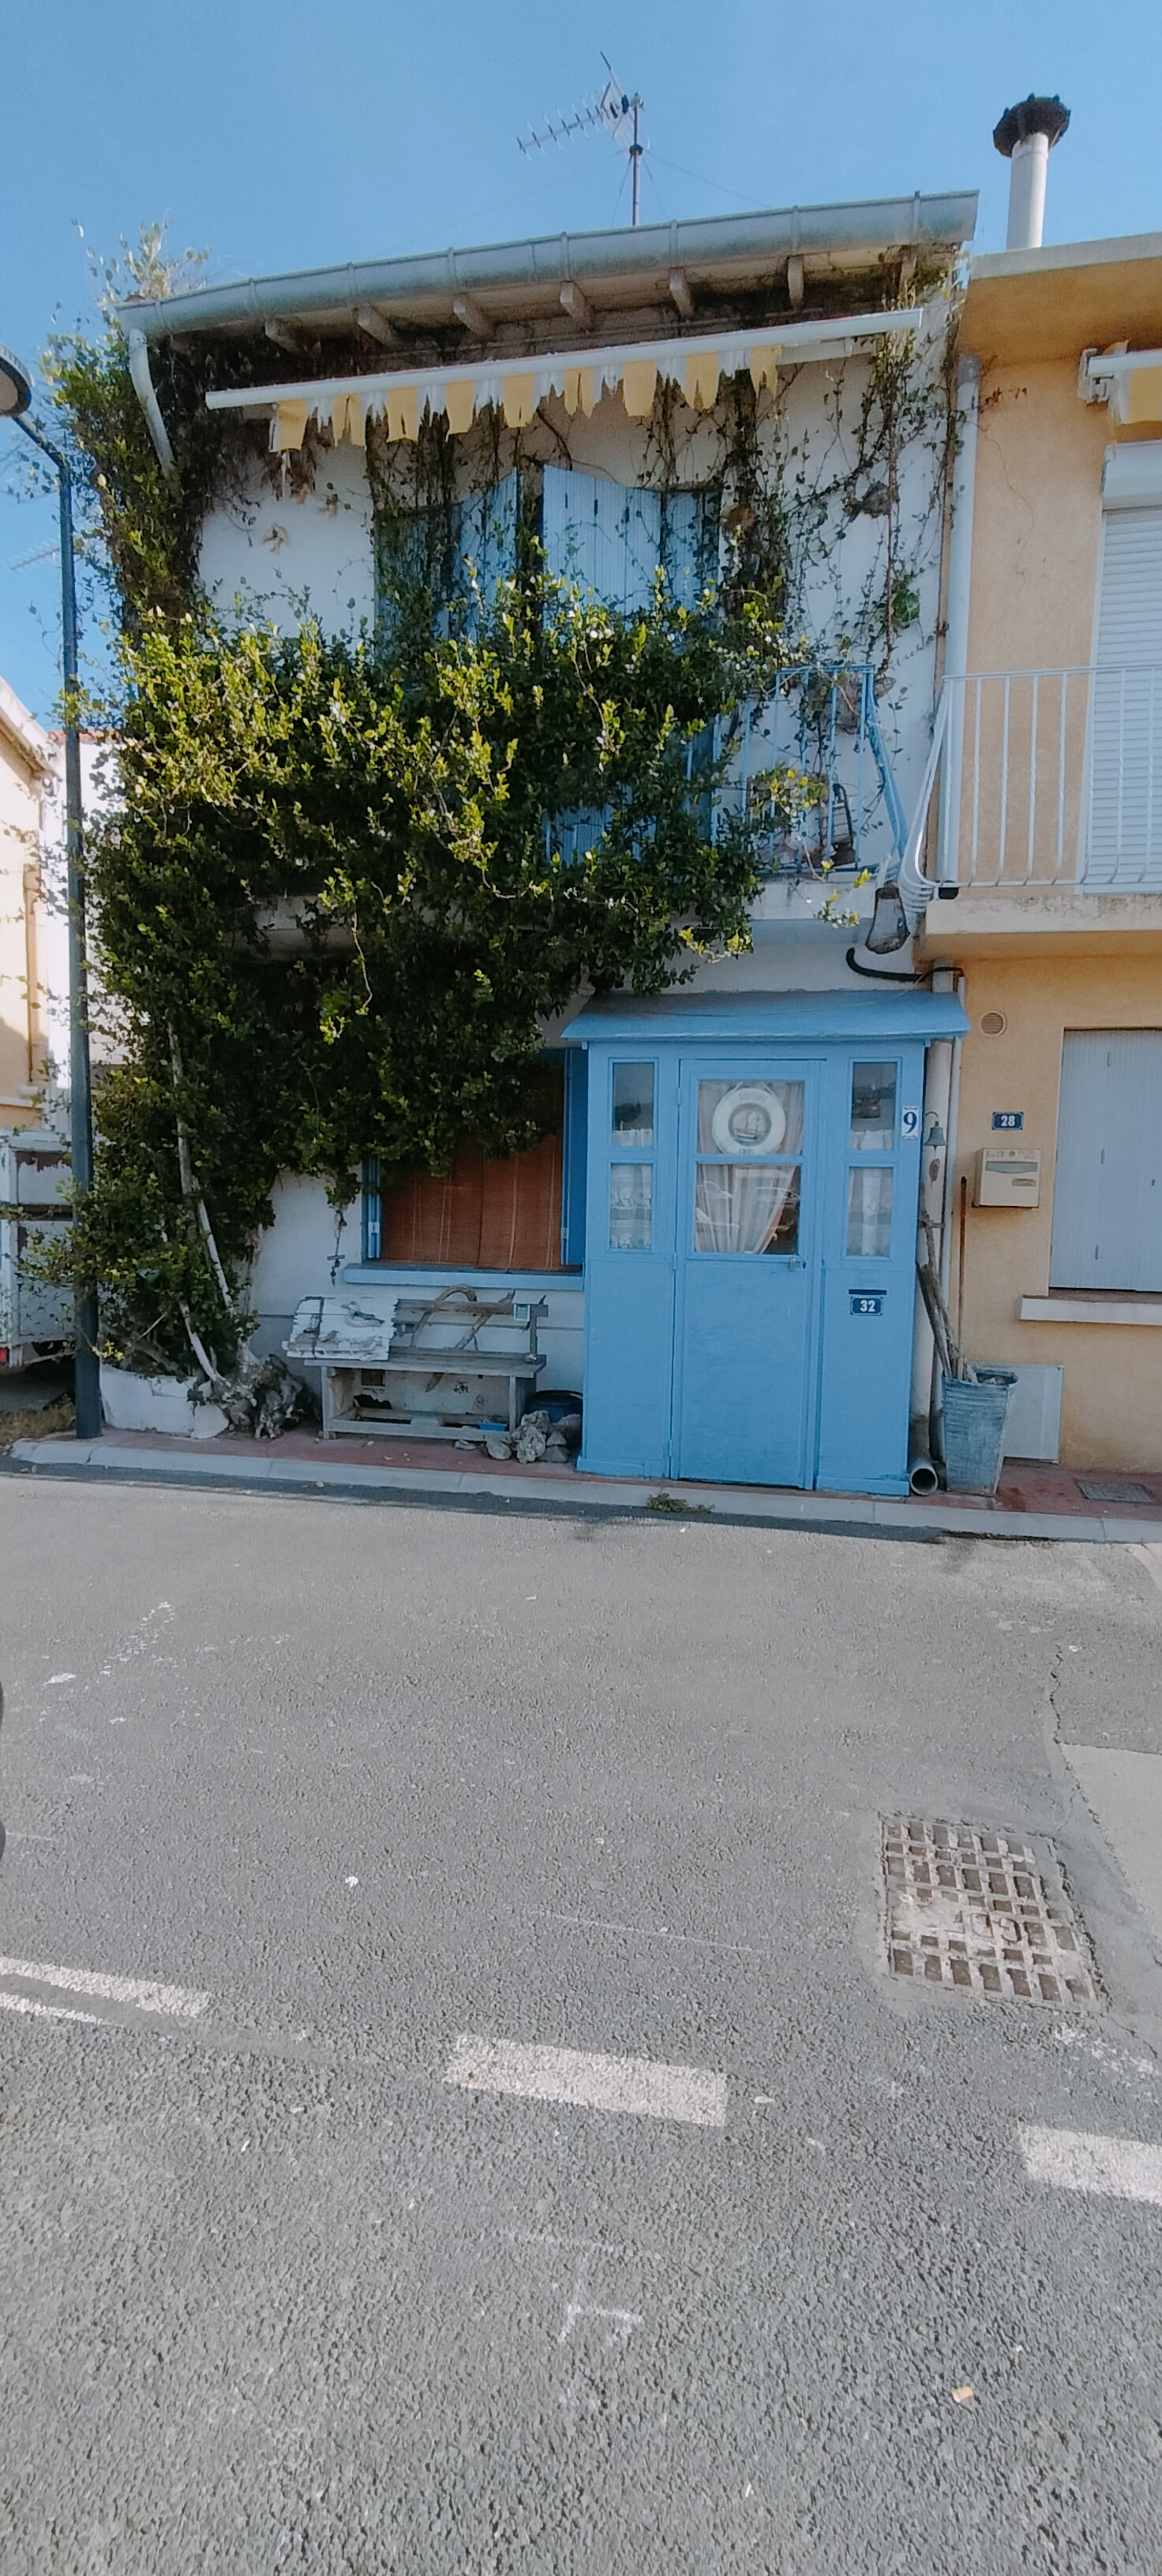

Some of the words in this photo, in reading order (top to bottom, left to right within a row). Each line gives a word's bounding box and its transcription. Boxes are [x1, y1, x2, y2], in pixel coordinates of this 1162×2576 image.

[903, 1111, 917, 1134] 9
[1000, 1114, 1016, 1127] 28
[860, 1299, 876, 1312] 32
